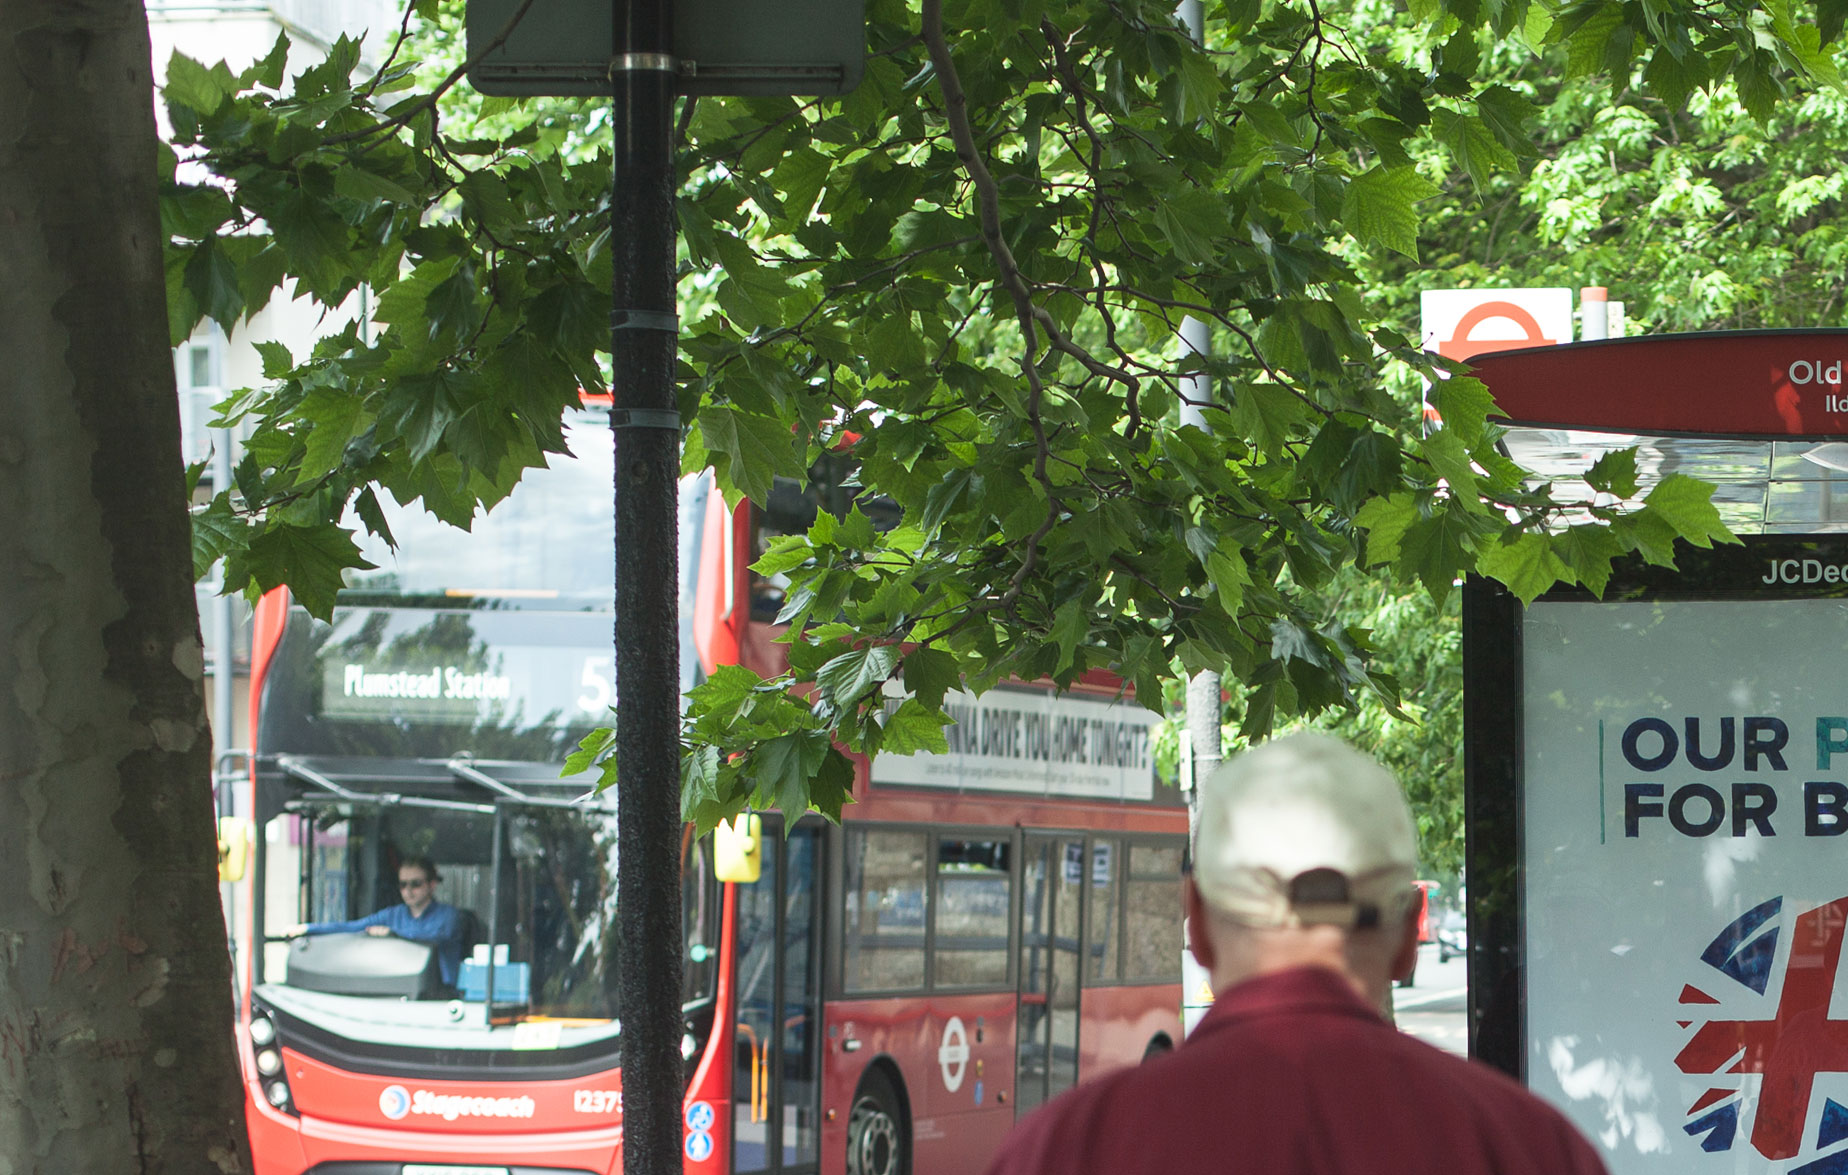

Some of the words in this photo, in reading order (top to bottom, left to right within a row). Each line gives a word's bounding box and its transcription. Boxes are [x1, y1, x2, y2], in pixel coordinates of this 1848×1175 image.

[1788, 360, 1842, 385] Old
[343, 663, 441, 698] Plumstead
[443, 665, 511, 700] Station
[1621, 716, 1790, 772] OUR
[1624, 782, 1778, 838] FOR
[411, 1089, 536, 1121] Stagecoach
